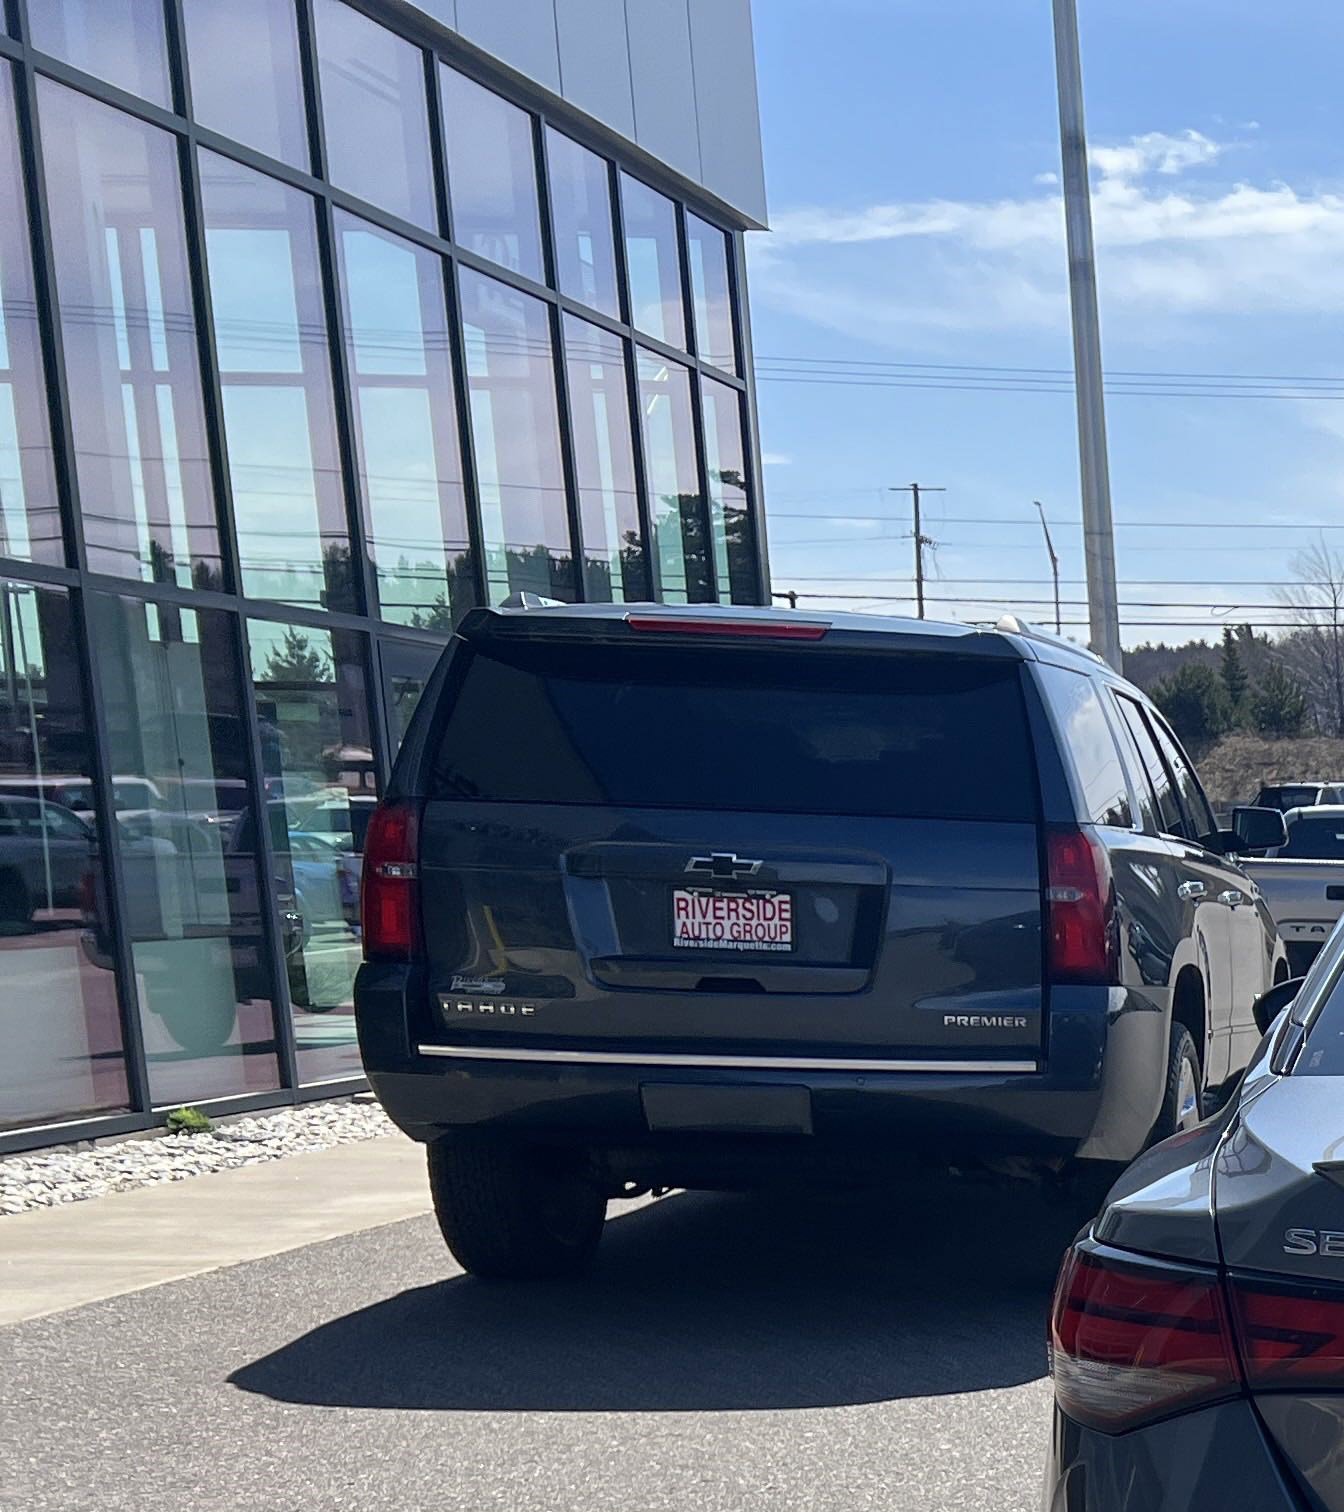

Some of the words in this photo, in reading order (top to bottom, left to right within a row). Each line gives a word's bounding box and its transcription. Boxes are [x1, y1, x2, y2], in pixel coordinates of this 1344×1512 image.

[675, 897, 791, 922] RIVERSIDE
[680, 921, 724, 941] AUTO
[730, 922, 789, 941] GROUP
[943, 1015, 1027, 1028] PREMIER
